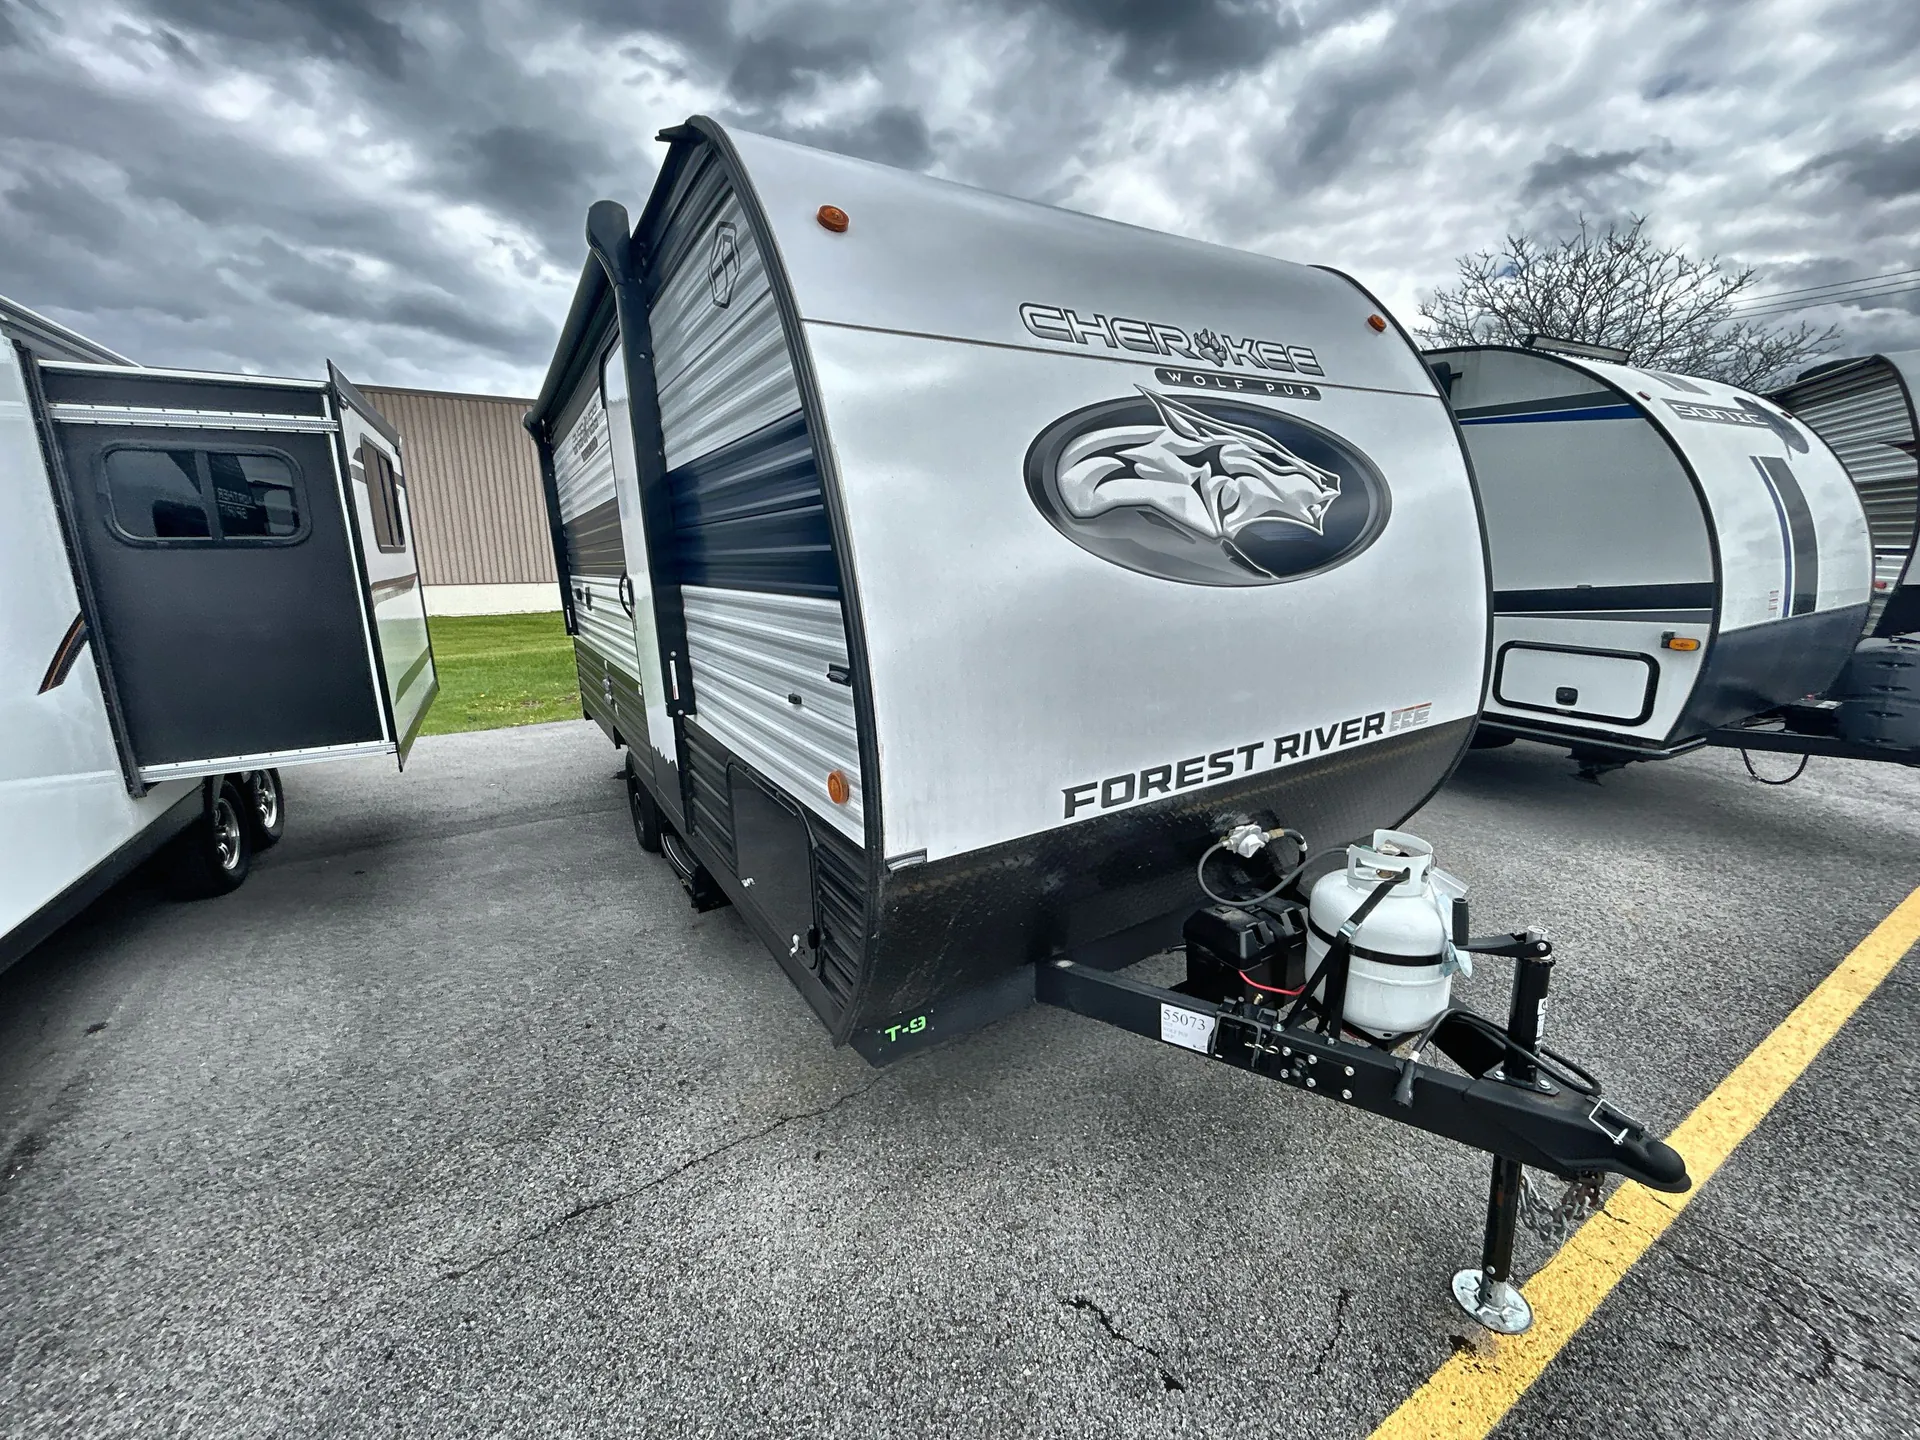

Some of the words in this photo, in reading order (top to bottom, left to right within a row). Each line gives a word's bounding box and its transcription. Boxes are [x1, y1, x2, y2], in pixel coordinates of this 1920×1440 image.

[1019, 302, 1325, 377] CHEROKEE
[1166, 371, 1244, 390] WOLF
[1266, 383, 1311, 397] PUP
[1671, 404, 1769, 425] SONIC
[1061, 741, 1264, 819] FOREST
[1273, 711, 1385, 764] RIVER
[884, 1016, 927, 1042] T-9
[1163, 1009, 1206, 1031] 55073
